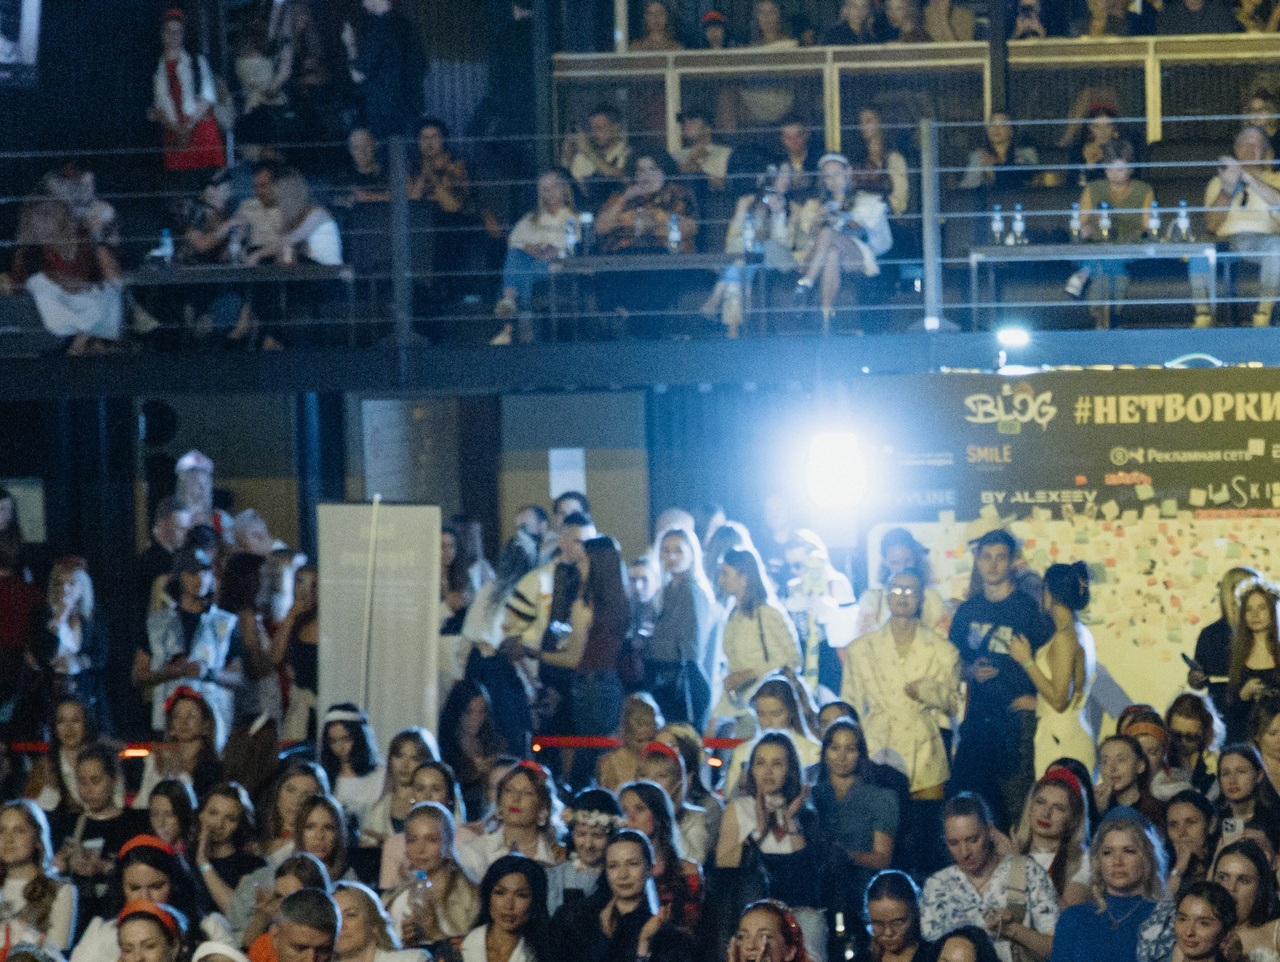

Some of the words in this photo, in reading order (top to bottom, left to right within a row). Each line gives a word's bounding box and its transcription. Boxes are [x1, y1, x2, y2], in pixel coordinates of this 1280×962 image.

[964, 392, 1057, 432] BLOG
[966, 445, 1013, 463] SMILE
[981, 491, 1006, 504] BY
[1010, 490, 1098, 503] ALEXEEV
